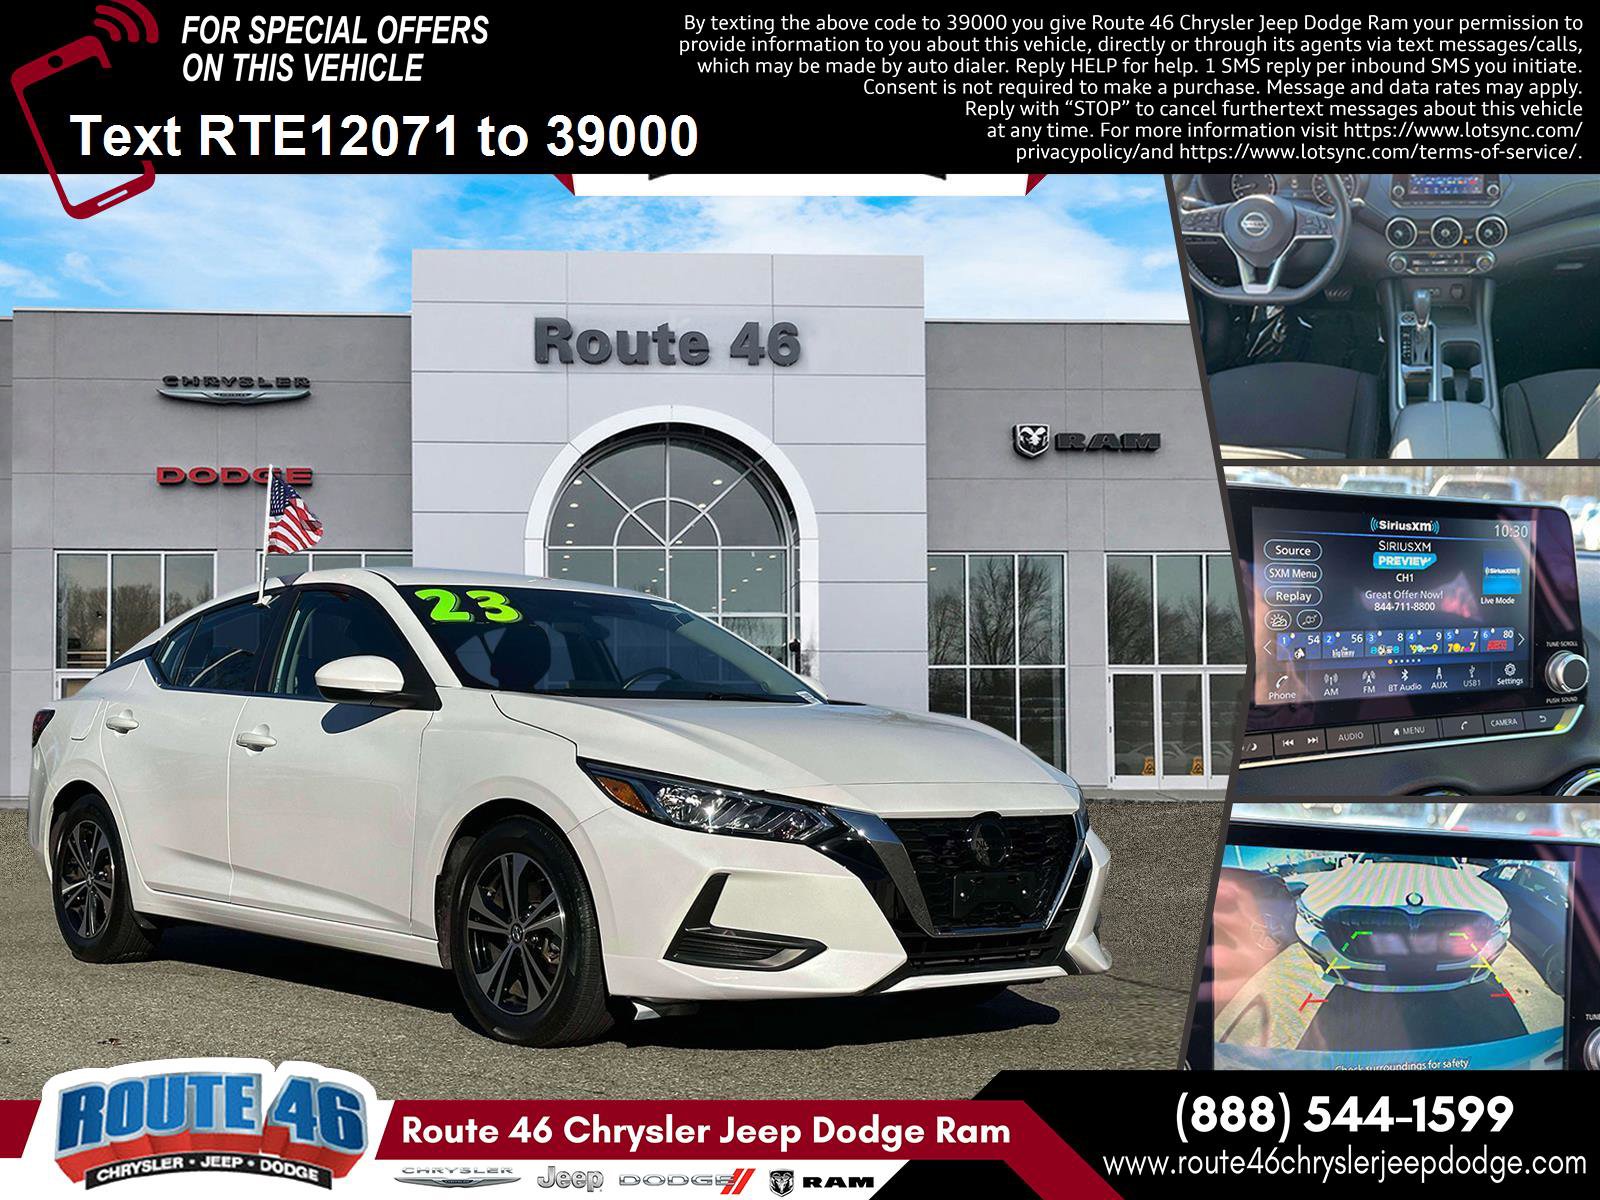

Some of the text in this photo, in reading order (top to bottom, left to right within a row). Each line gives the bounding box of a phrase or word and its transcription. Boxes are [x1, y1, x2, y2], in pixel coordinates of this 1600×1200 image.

[534, 317, 801, 367] Route 46
[162, 375, 311, 388] CHRYSLER
[1055, 432, 1161, 451] RAM
[156, 466, 313, 485] DODGE
[1494, 525, 1529, 538] 10:30
[1275, 545, 1311, 556] Source
[1379, 540, 1432, 552] SIRIUSXM
[1378, 556, 1431, 567] PREVIEW
[1269, 568, 1317, 579] SXM Menu
[1396, 574, 1414, 582] CH1
[1276, 591, 1312, 603] Replay
[1365, 590, 1444, 599] Great Offer Now!
[414, 588, 523, 624] 23
[1480, 597, 1516, 605] Live Mode
[1374, 602, 1436, 611] 844-711-8800
[1400, 683, 1422, 691] Audio
[1497, 678, 1524, 686] Settings
[1269, 692, 1296, 700] Phone
[1324, 688, 1339, 696] AM
[1490, 718, 1518, 727] CAMERA
[1403, 726, 1425, 735] MENU
[1338, 732, 1364, 742] AUDIO
